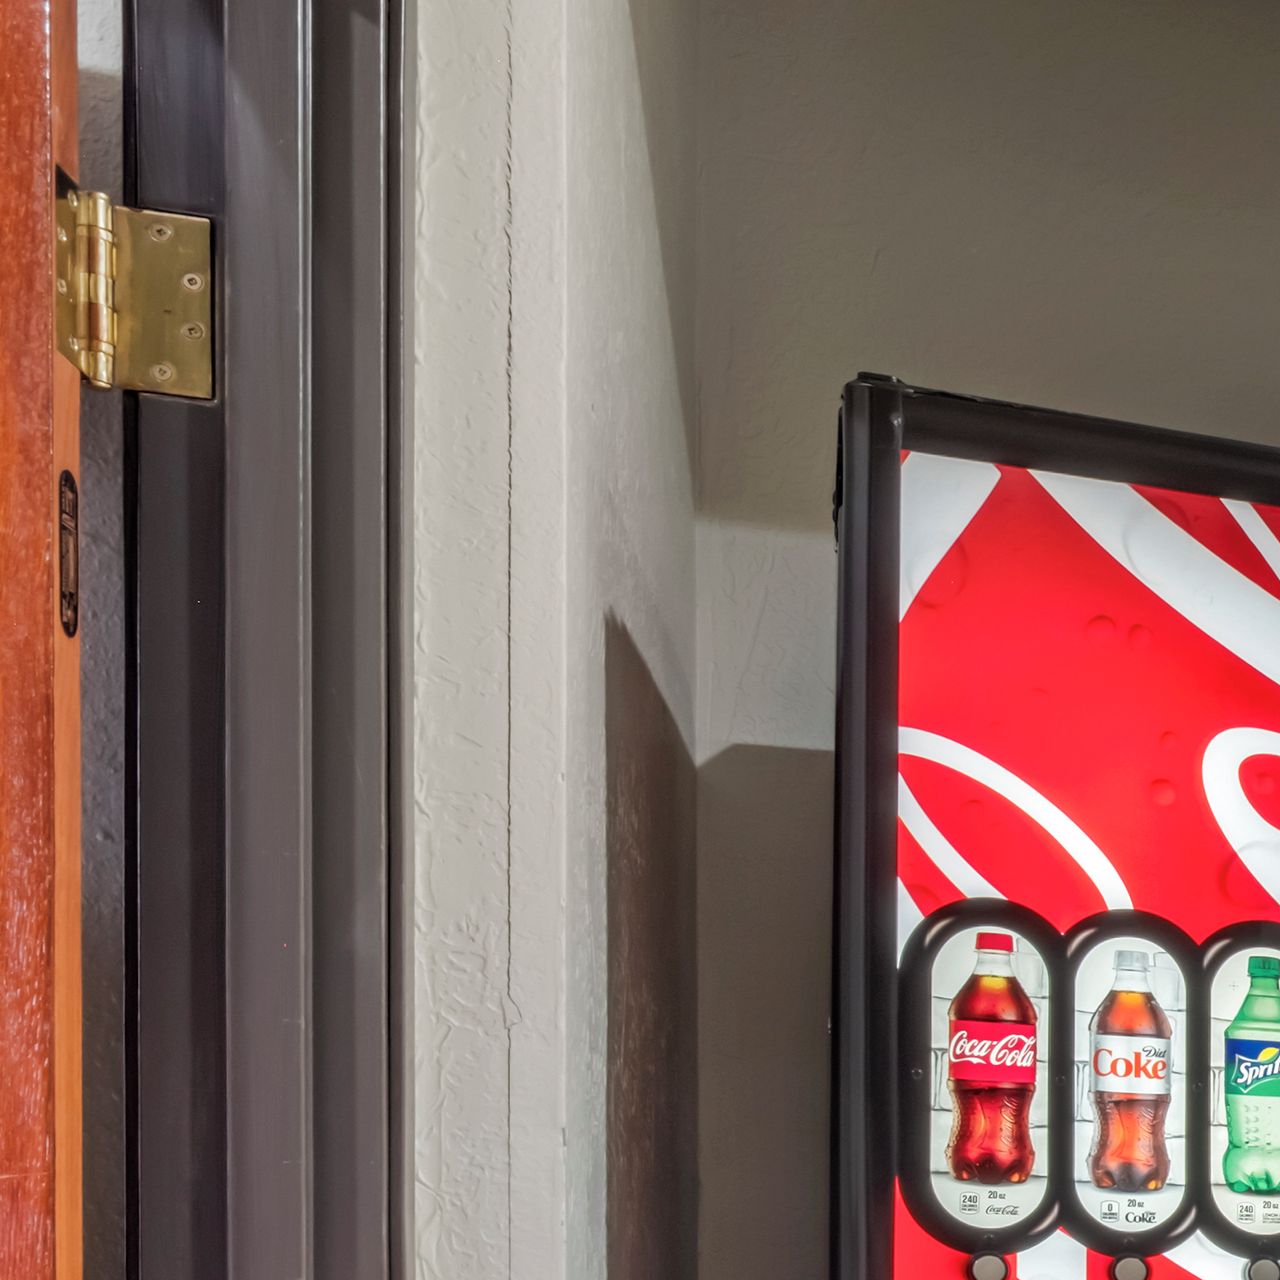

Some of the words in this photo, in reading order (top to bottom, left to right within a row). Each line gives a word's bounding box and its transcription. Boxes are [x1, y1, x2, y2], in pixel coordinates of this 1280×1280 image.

[950, 1030, 1036, 1069] Coca-Cola
[1142, 1045, 1167, 1059] Diet
[1093, 1048, 1167, 1080] Coke
[988, 1190, 998, 1199] 20
[962, 1195, 978, 1204] 240
[1127, 1199, 1137, 1207] 20
[1107, 1203, 1113, 1211] 0
[1239, 1205, 1254, 1213] 240
[1263, 1201, 1271, 1209] 20
[1125, 1212, 1157, 1224] Coke
